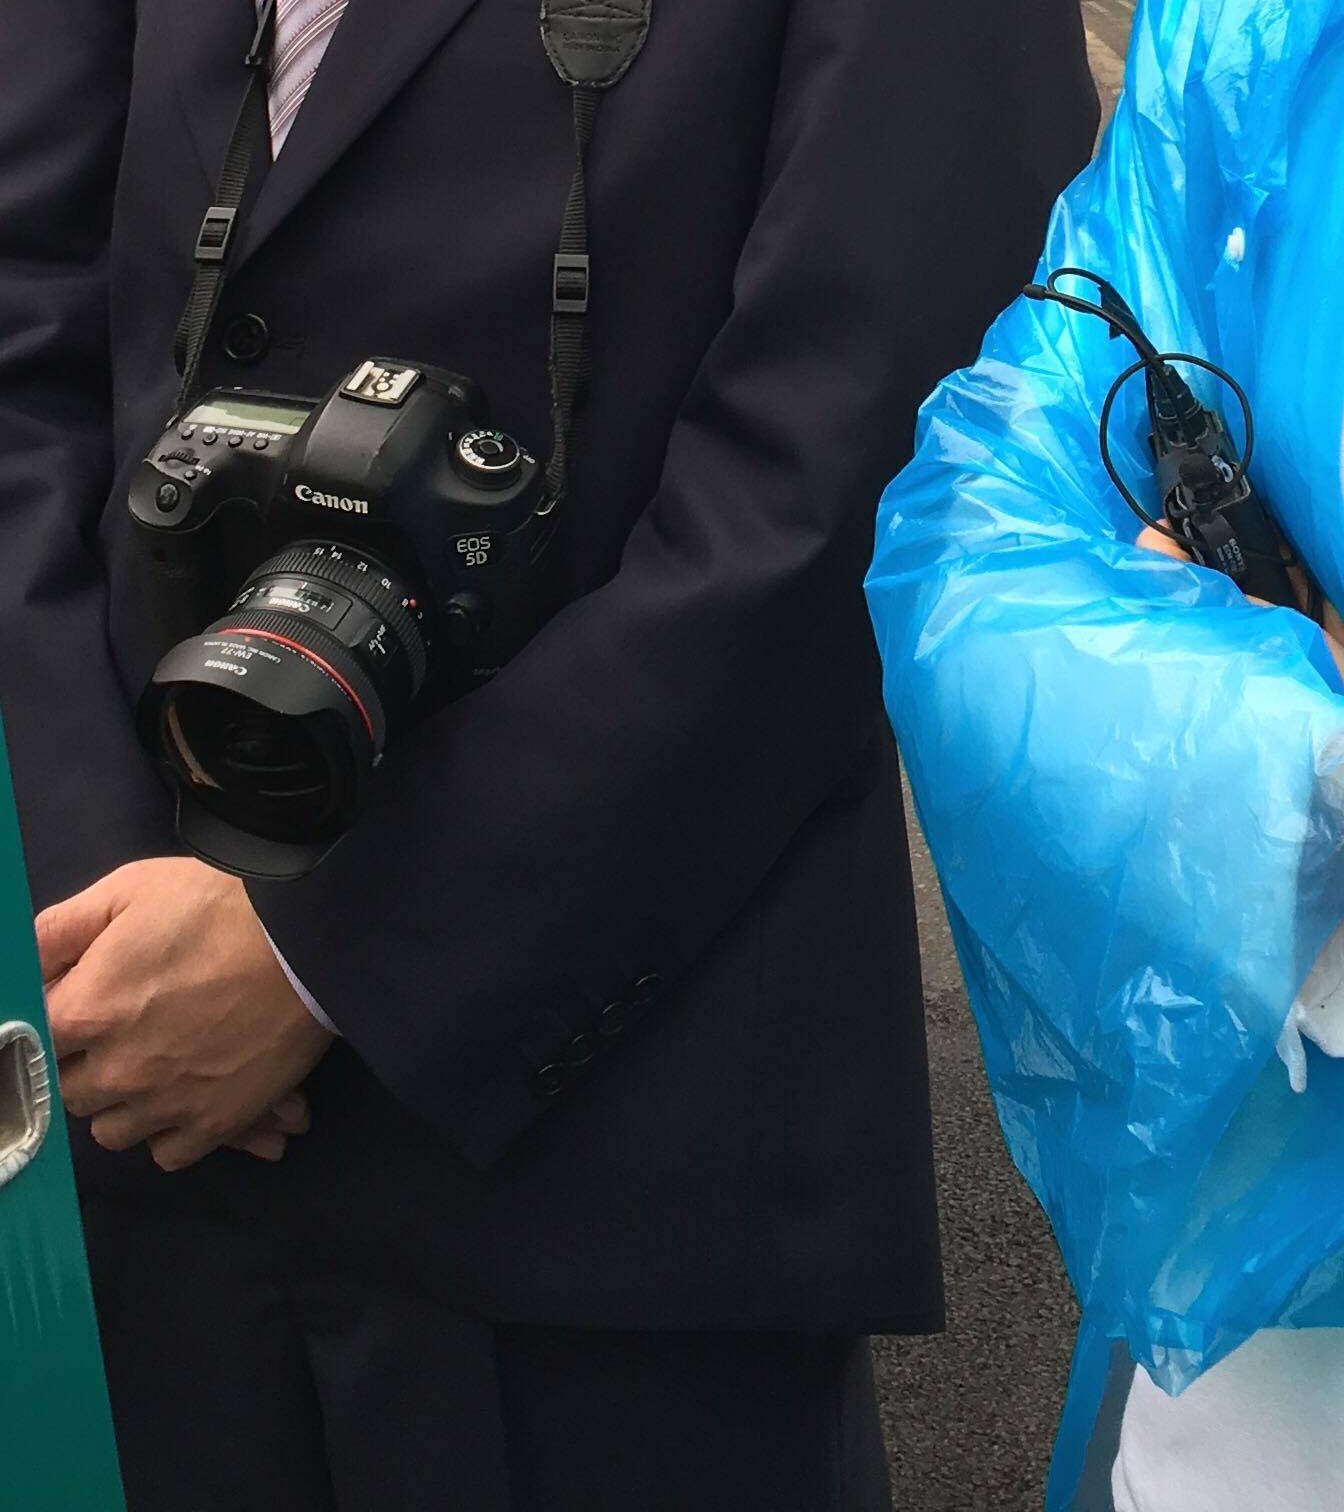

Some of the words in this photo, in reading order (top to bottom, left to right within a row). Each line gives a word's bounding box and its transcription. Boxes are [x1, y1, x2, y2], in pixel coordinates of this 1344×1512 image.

[294, 484, 369, 514] Canon
[456, 536, 491, 553] EOS
[465, 551, 488, 567] 5D
[356, 561, 368, 572] 12
[381, 578, 392, 590] 10
[204, 659, 248, 676] Canon
